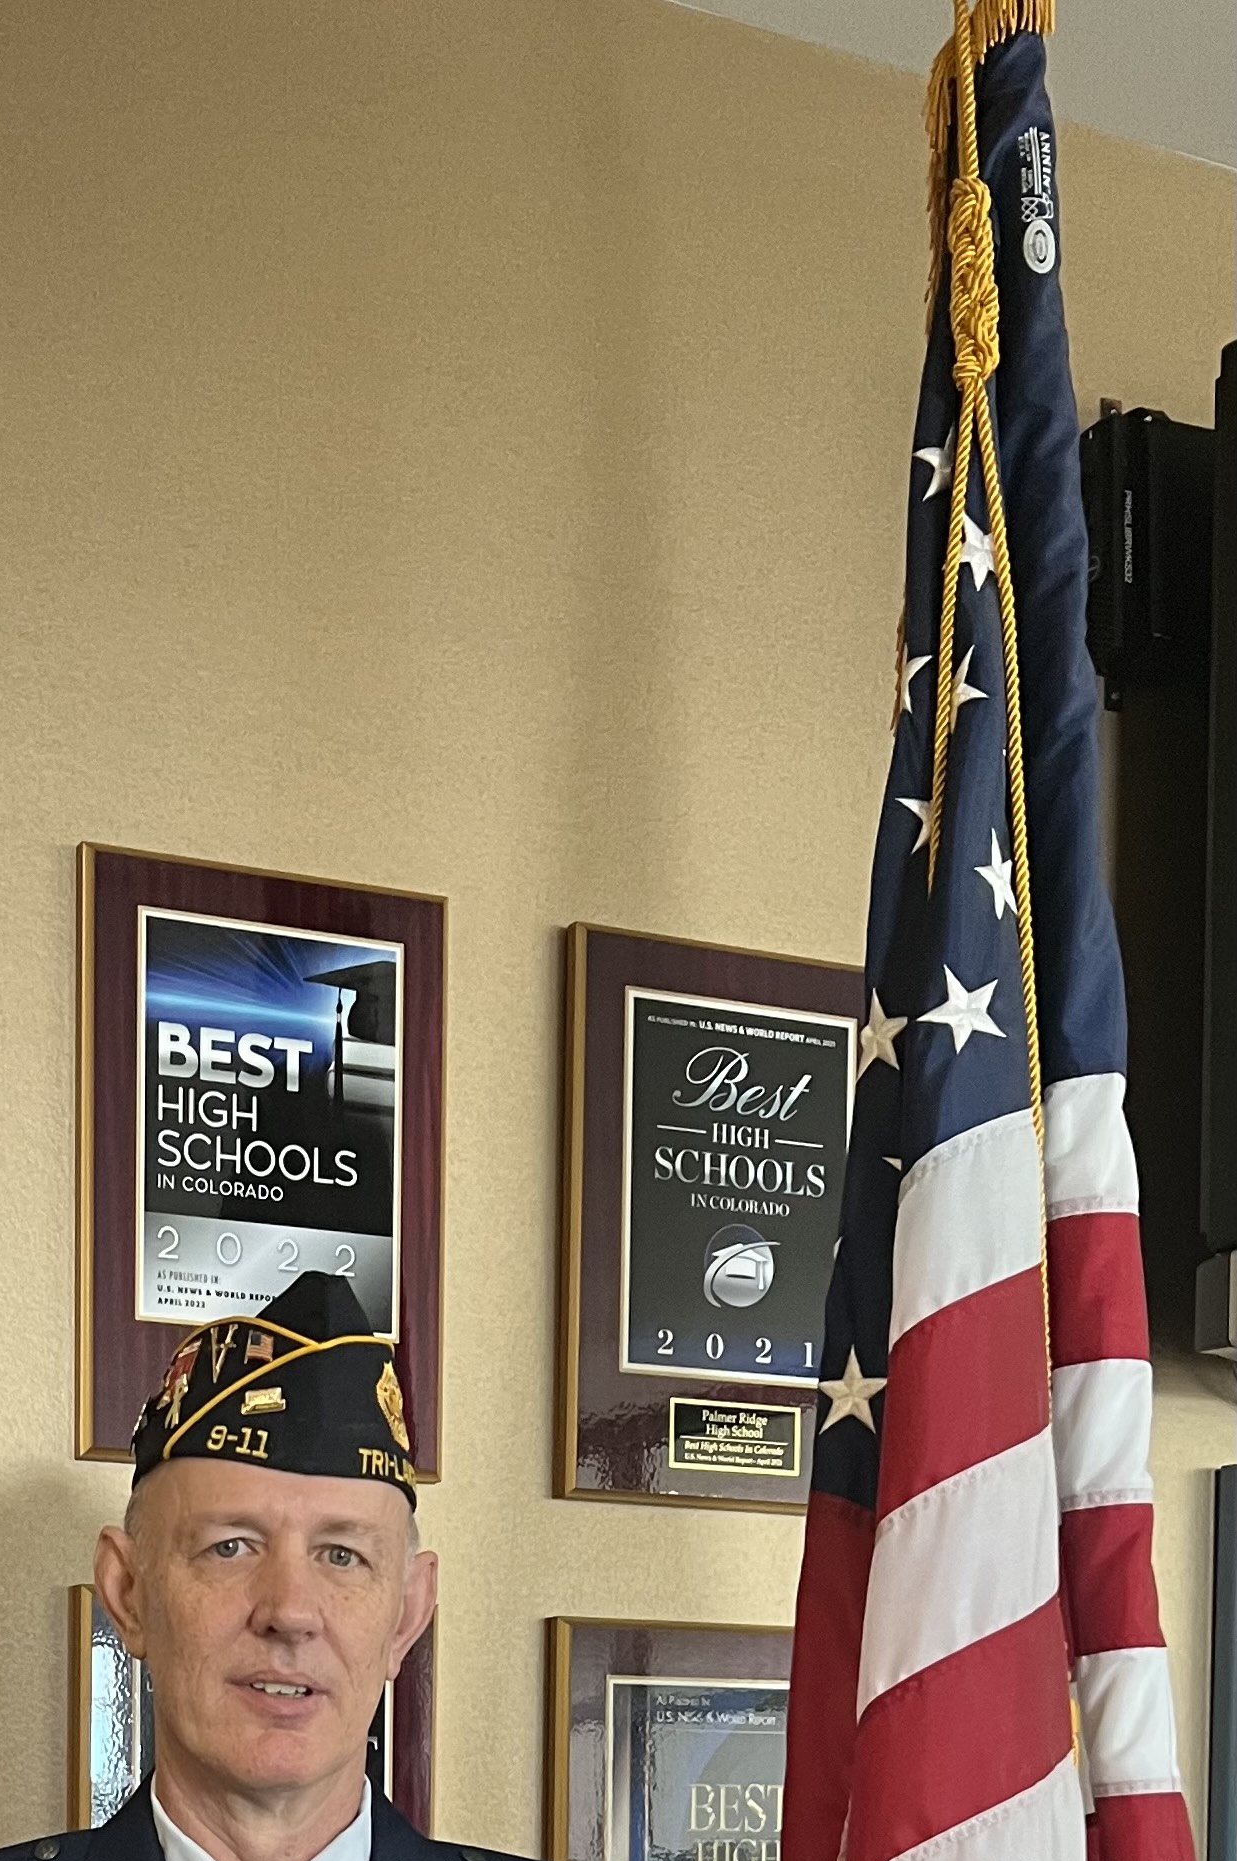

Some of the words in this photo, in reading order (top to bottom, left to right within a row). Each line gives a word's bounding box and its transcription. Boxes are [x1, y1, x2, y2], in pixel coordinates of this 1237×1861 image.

[698, 1020, 714, 1031] U.S.
[714, 1022, 737, 1034] NEWS
[739, 1026, 745, 1035] &
[745, 1027, 774, 1039] WORLD
[775, 1031, 805, 1043] REPORT
[158, 1021, 313, 1092] BEST
[672, 1046, 812, 1121] Best
[158, 1084, 257, 1132] HIGH
[712, 1122, 769, 1149] HIGH
[158, 1129, 358, 1187] SCHOOLS
[654, 1145, 826, 1198] SCHOOLS
[157, 1174, 175, 1190] IN
[182, 1176, 284, 1202] COLORADO
[691, 1193, 707, 1209] IN
[709, 1195, 790, 1217] COLORADO
[157, 1269, 167, 1280] AS
[169, 1270, 207, 1284] PUBLISHED
[157, 1297, 182, 1307] APRIL
[177, 1286, 202, 1296] NEWS
[215, 1290, 246, 1300] WORLD
[702, 1409, 737, 1424] Palmer
[739, 1412, 768, 1428] Ridge
[705, 1423, 731, 1439] High
[731, 1425, 763, 1439] School
